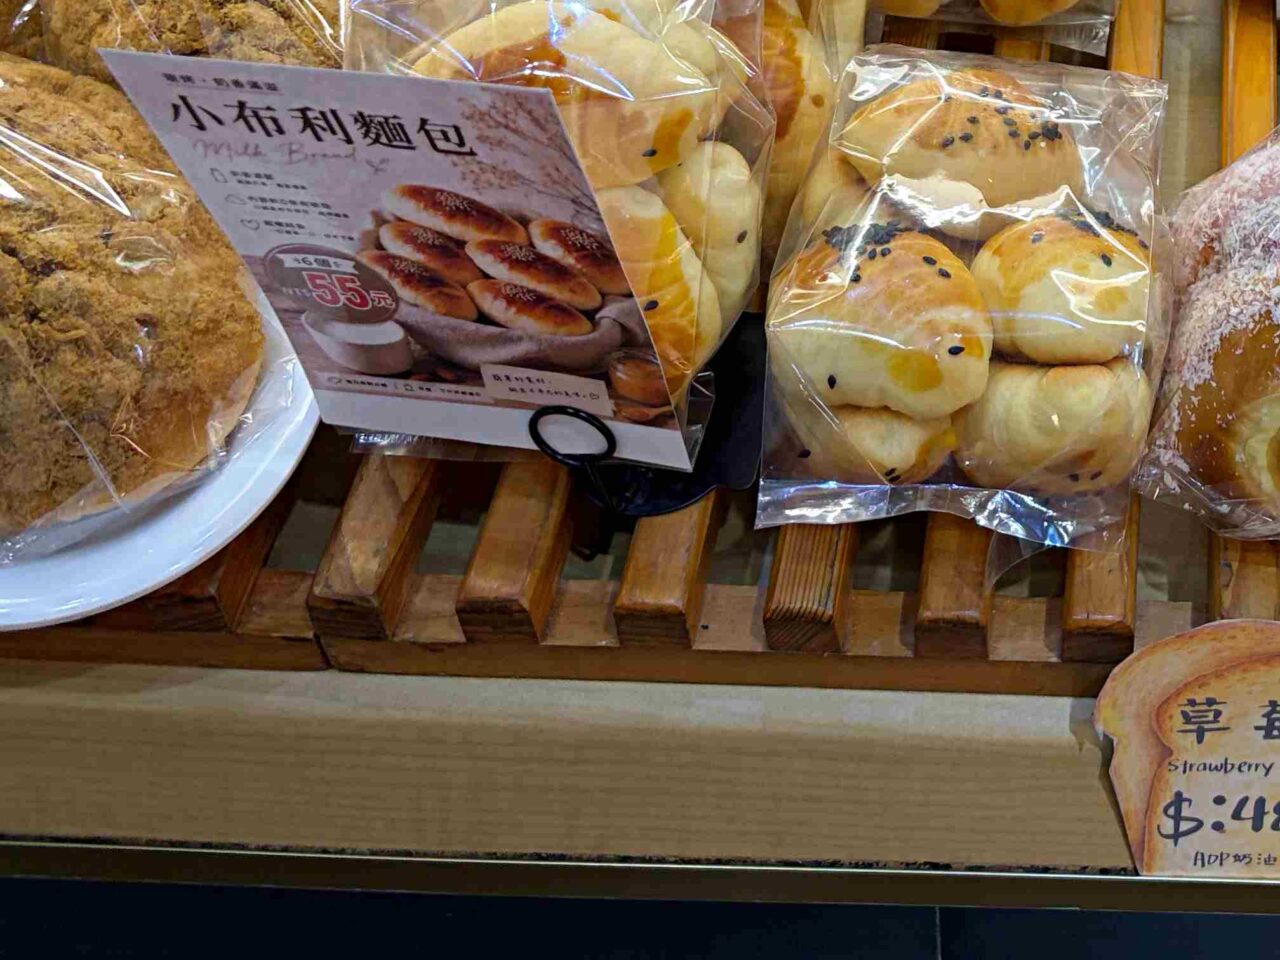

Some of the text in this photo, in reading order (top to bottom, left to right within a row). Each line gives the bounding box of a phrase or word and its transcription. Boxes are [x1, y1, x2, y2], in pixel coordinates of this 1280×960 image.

[171, 94, 478, 157] 小布利麵包
[1167, 756, 1275, 777] Strawberry
